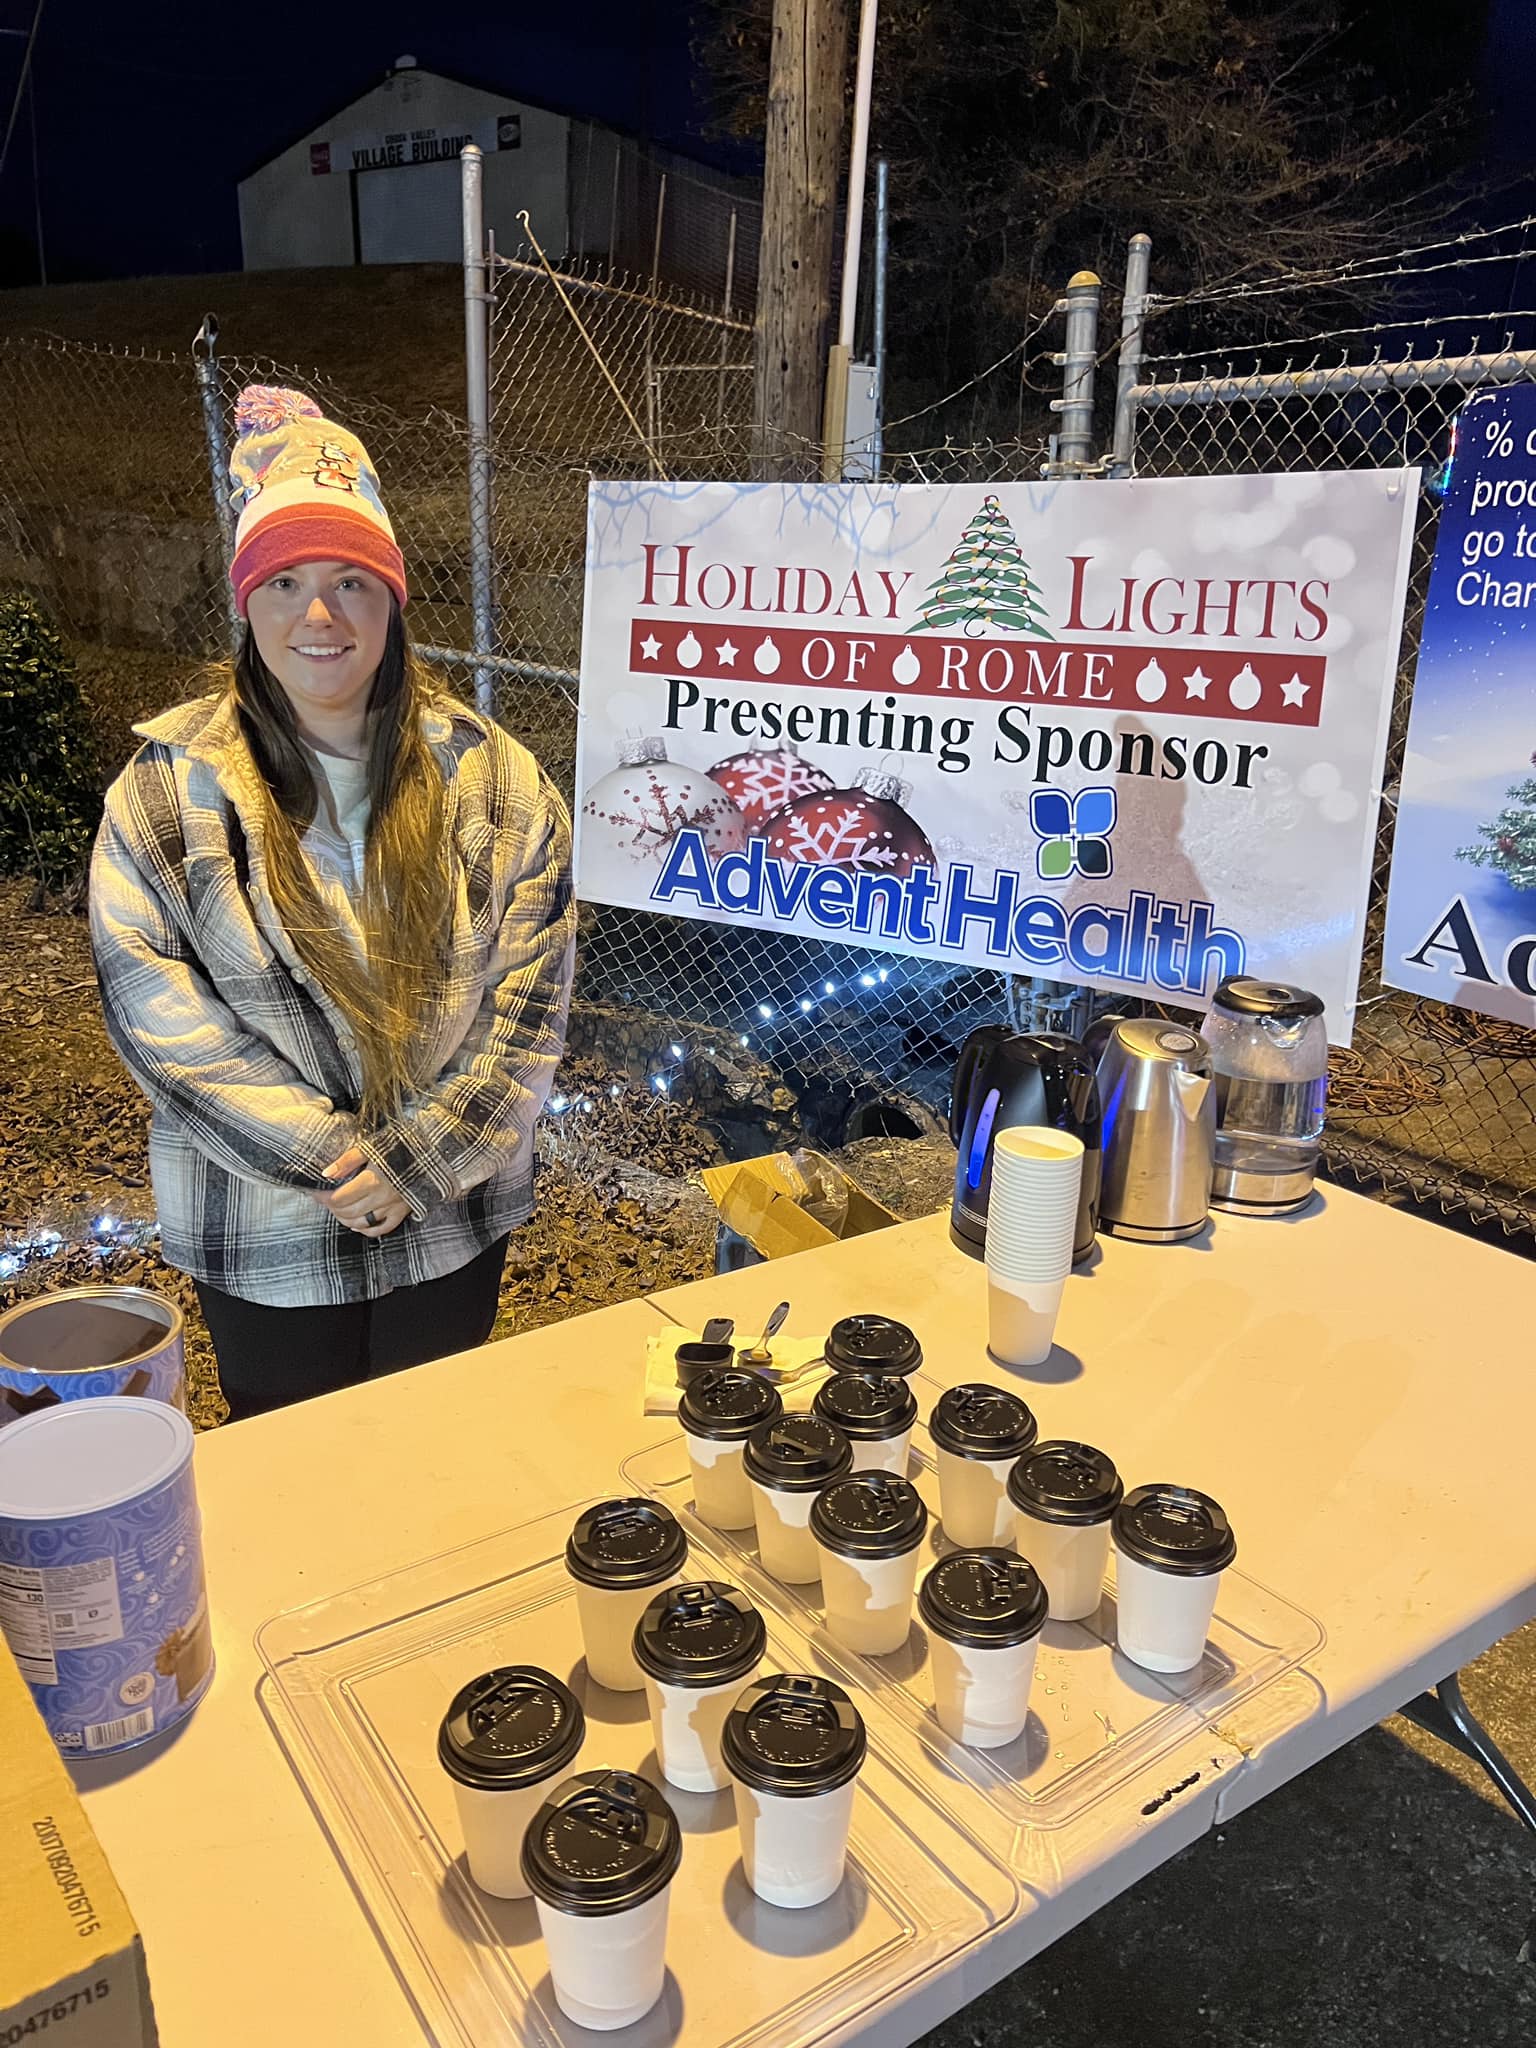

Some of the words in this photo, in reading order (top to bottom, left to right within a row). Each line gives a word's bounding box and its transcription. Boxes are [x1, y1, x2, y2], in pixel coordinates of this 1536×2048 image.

[352, 144, 405, 169] VILLAGE
[1462, 531, 1504, 567] go
[802, 637, 876, 684] OF
[937, 645, 1115, 701] ROME
[661, 678, 975, 774] Presenting
[993, 705, 1269, 789] Sponsor
[650, 827, 1247, 997] AdventHealth
